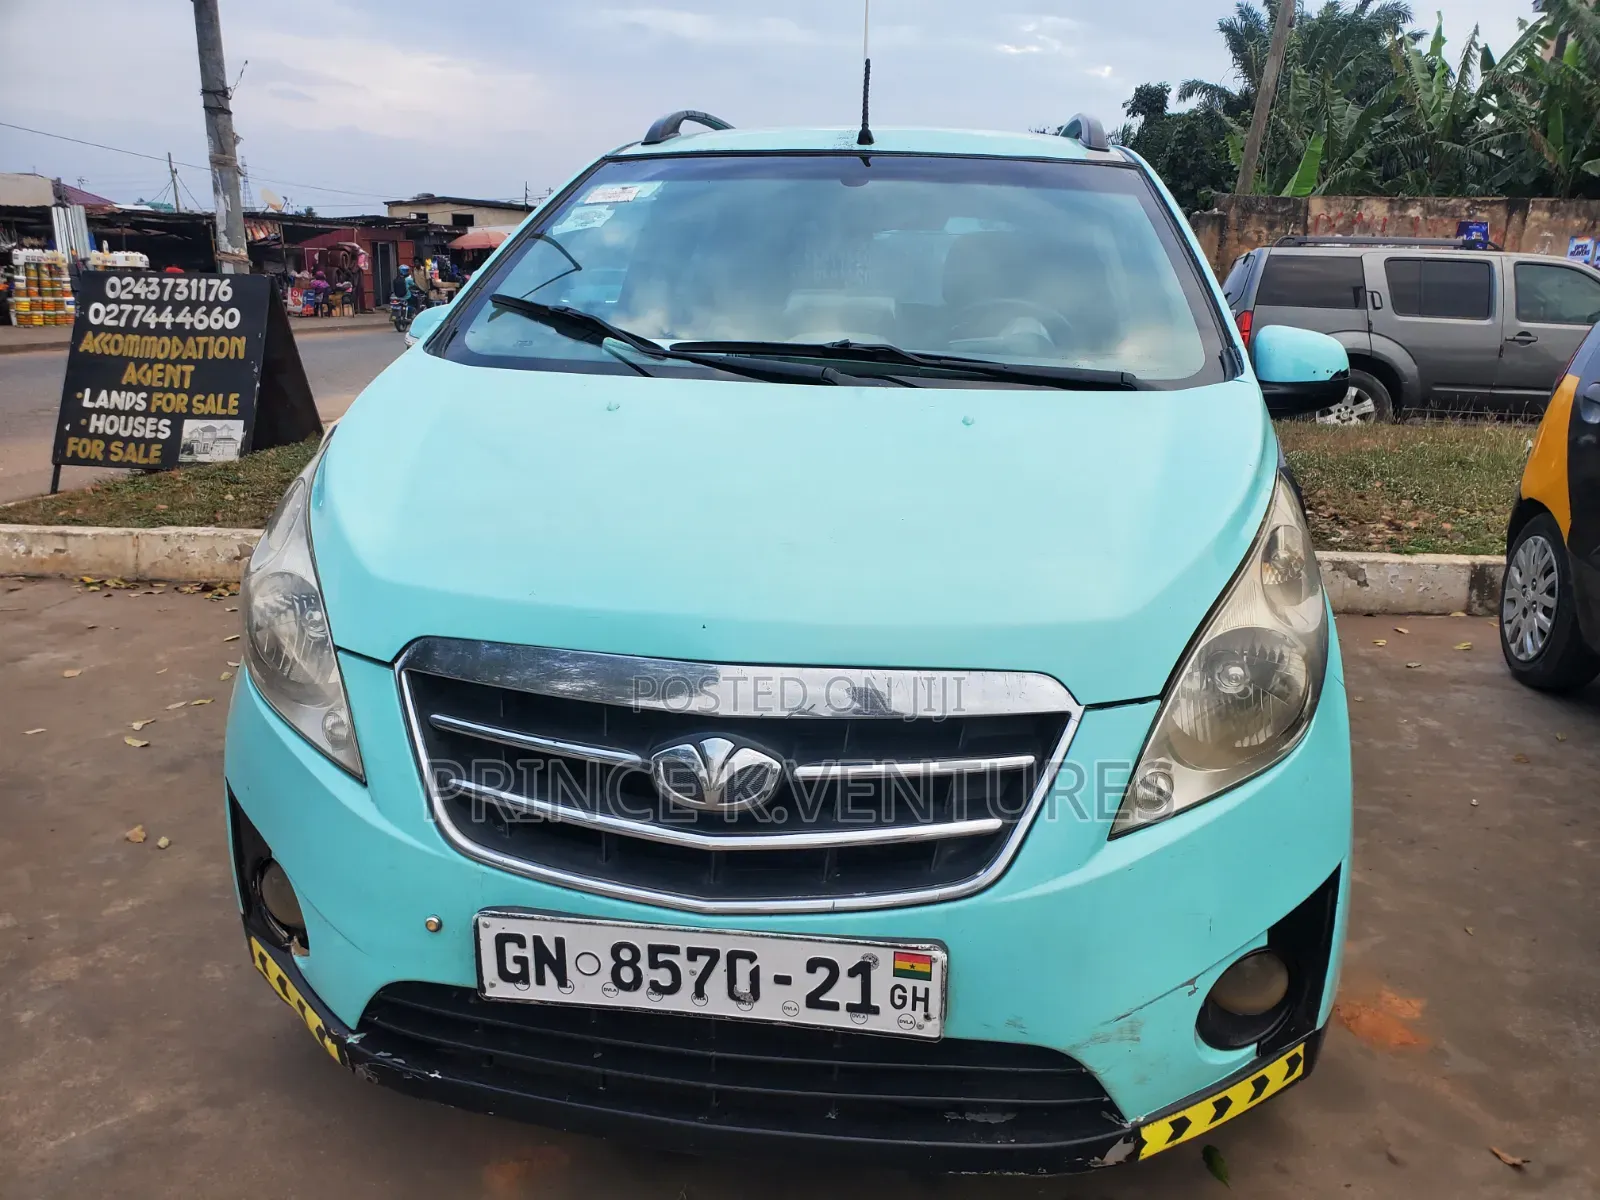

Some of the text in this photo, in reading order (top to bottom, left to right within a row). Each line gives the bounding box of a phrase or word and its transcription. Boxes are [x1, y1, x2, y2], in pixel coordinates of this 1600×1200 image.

[105, 276, 233, 302] 0243731176
[88, 302, 241, 330] 0277444660
[79, 331, 247, 360] ACCOMMODATION
[121, 362, 195, 389] AGENT
[150, 392, 189, 414] FOR
[192, 393, 240, 415] SALE
[66, 436, 163, 465] FOR SALE
[494, 931, 567, 988] GN
[889, 983, 930, 1013] GH
[899, 1018, 914, 1026] DVLA
